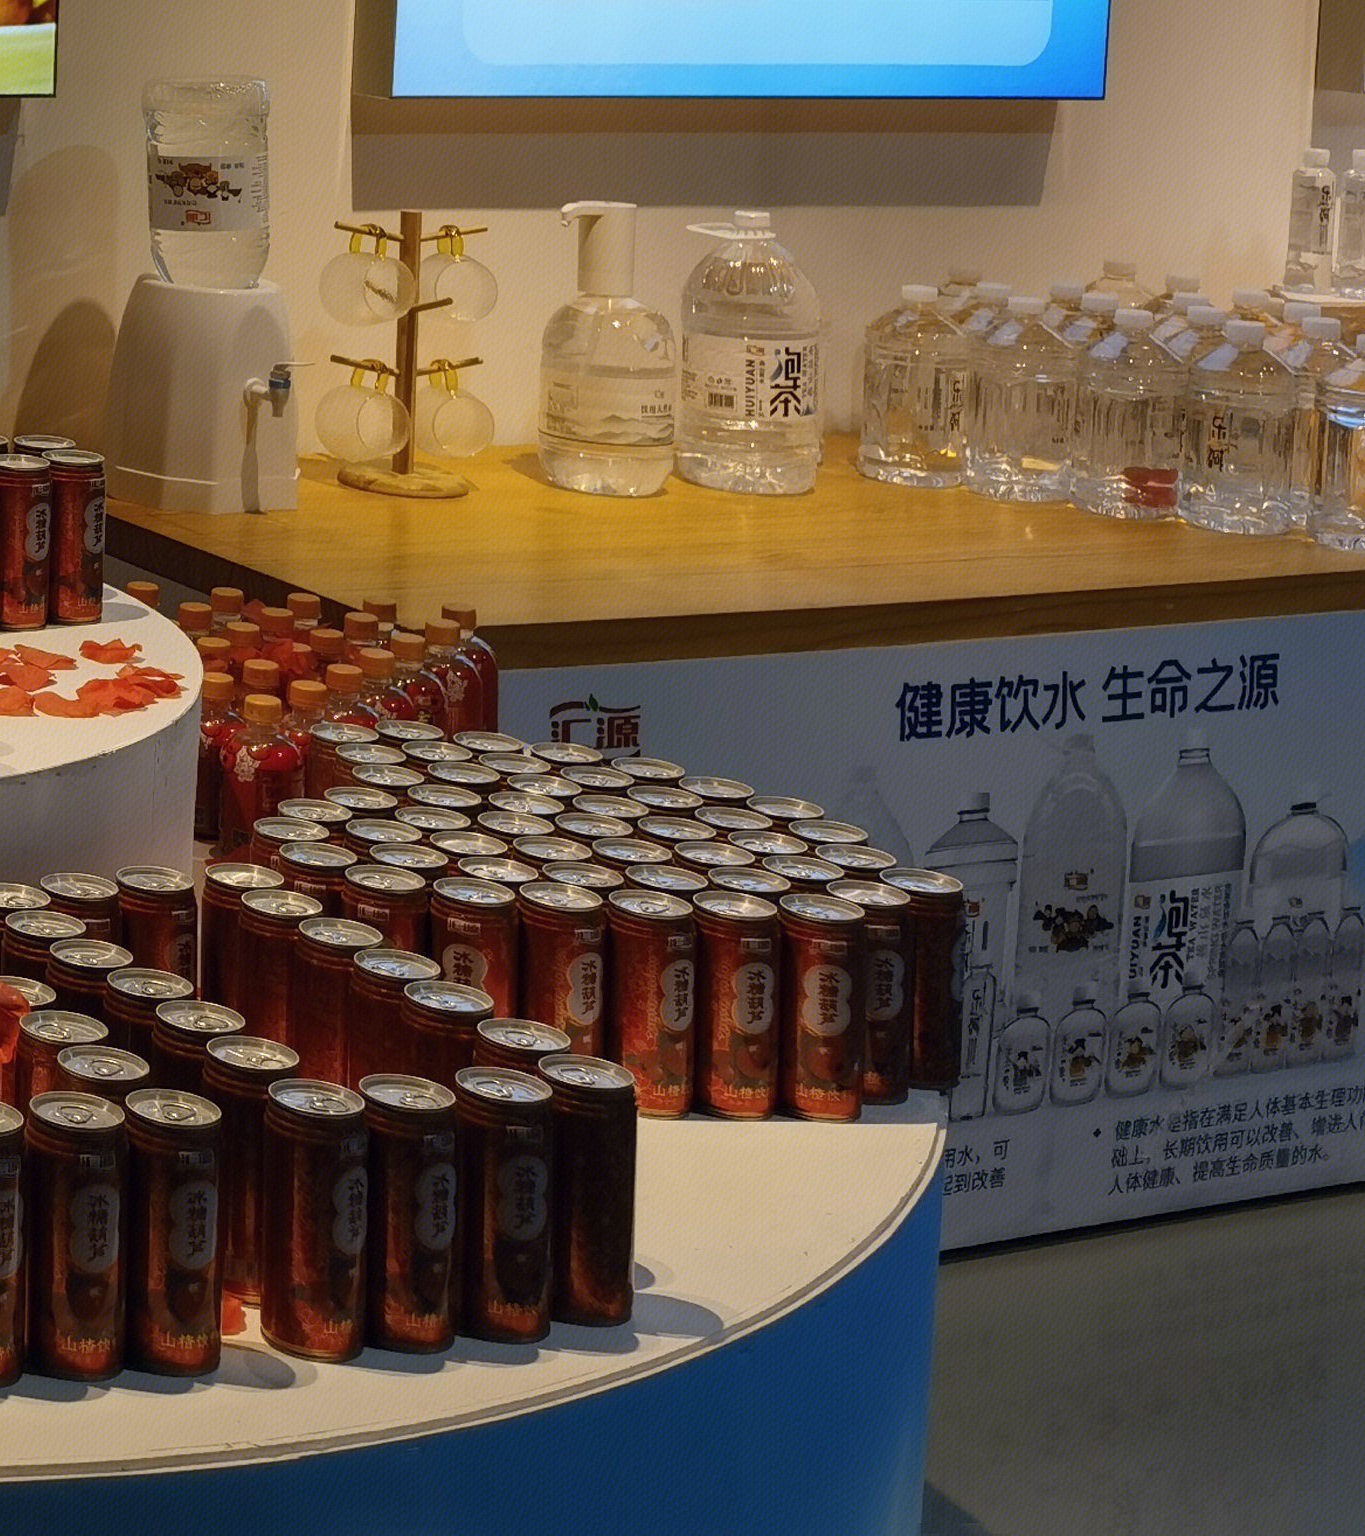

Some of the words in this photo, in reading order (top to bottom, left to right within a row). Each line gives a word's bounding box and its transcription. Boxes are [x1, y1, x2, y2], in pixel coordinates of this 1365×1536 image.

[745, 359, 755, 416] HUIYUAN
[894, 671, 1087, 741] 健康饮水
[1102, 652, 1281, 726] 生命之源
[1128, 915, 1142, 980] UIYUAN
[1115, 1085, 1365, 1142] 健康水是指在满足人体基本生理功
